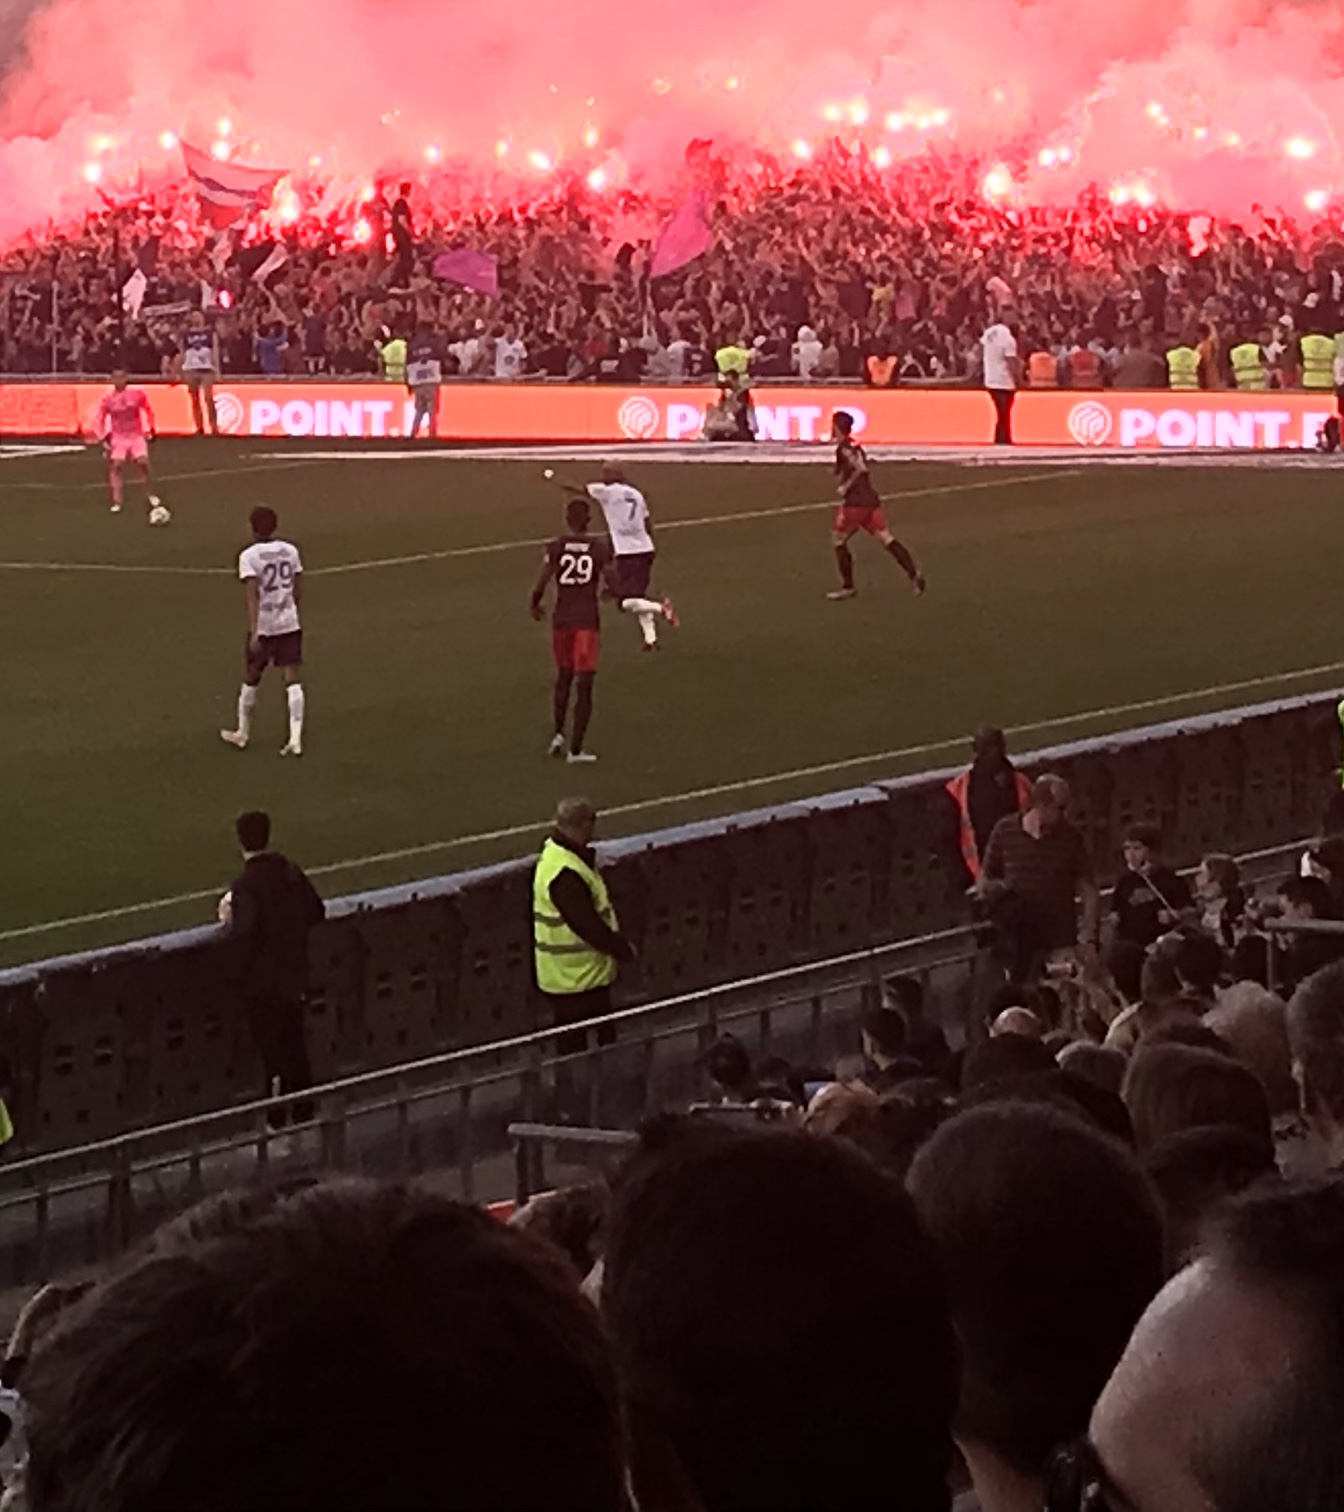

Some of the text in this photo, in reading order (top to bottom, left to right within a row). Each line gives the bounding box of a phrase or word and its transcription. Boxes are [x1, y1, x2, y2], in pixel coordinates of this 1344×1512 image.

[624, 497, 637, 521] 7
[263, 560, 293, 593] 29
[559, 553, 593, 585] 29
